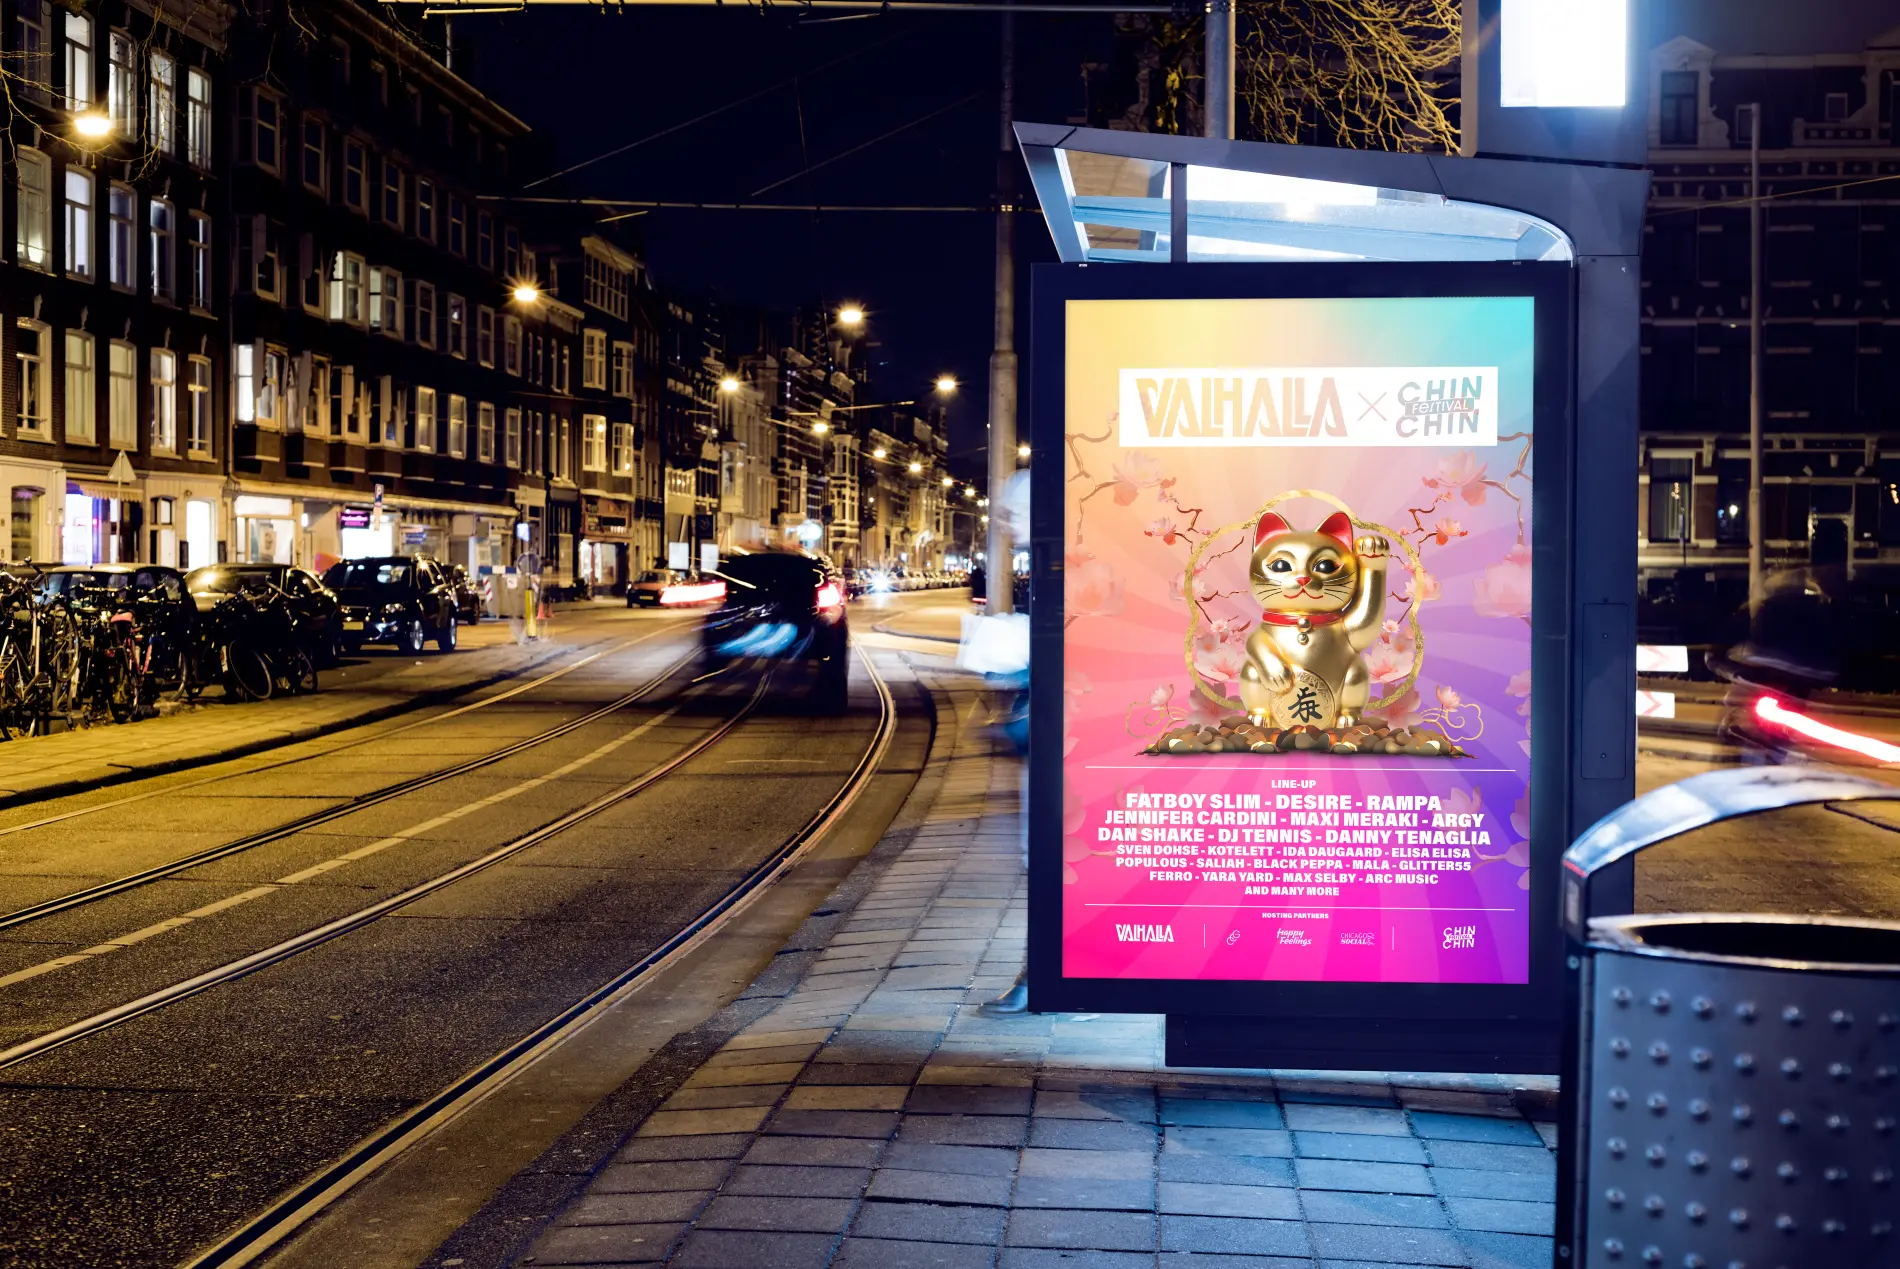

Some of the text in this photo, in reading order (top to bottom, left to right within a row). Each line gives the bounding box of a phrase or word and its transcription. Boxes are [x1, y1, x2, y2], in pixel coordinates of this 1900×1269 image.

[1397, 376, 1483, 407] CHIN
[1136, 377, 1348, 438] VALHALLA
[1395, 408, 1480, 438] CHIN
[1271, 779, 1317, 789] LINE-UP
[1126, 793, 1206, 809] FATBOY
[1209, 793, 1261, 809] SLIM
[1276, 794, 1352, 810] DESIRE
[1367, 795, 1442, 811] RAMPA
[1104, 810, 1194, 825] JENNIFER
[1197, 811, 1277, 826] CARDINI
[1290, 812, 1339, 826] MAXI
[1343, 812, 1418, 827] MERAKI
[1431, 813, 1485, 828] ARGY
[1097, 827, 1138, 842] DAN
[1140, 828, 1205, 842] SHAKE
[1218, 828, 1239, 843] DJ
[1242, 829, 1313, 843] TENNIS
[1325, 829, 1393, 844] DANNY
[1394, 830, 1492, 846] TENAGLIA
[1117, 845, 1152, 855] SVEN
[1153, 845, 1199, 855] DOHSE
[1207, 845, 1275, 856] KOTELETT
[1283, 846, 1306, 857] IDA
[1308, 847, 1383, 858] DAUGAARD
[1391, 847, 1430, 858] ELISA
[1432, 848, 1471, 859] ELISA
[1115, 857, 1188, 868] POPULOUS
[1196, 858, 1245, 869] SALIAH
[1253, 859, 1299, 869] BLACK
[1300, 859, 1344, 870] PEPPA
[1352, 860, 1391, 870] MALA
[1398, 860, 1472, 871] GLITTER55
[1149, 870, 1193, 881] FERRO
[1201, 871, 1237, 882] YARA
[1238, 872, 1274, 882] YARD
[1282, 872, 1313, 883] MAX
[1314, 873, 1357, 884] SELBY
[1365, 873, 1393, 884] ARC
[1394, 873, 1439, 885] MUSIC
[1244, 886, 1340, 896] AND MANY MORE
[1293, 912, 1330, 920] PARTNERS
[1115, 923, 1175, 943] VALHALLA
[1276, 927, 1304, 939] Happy
[1443, 925, 1476, 936] CHIN
[1279, 936, 1312, 947] Feelings
[1442, 939, 1474, 949] CHIN
